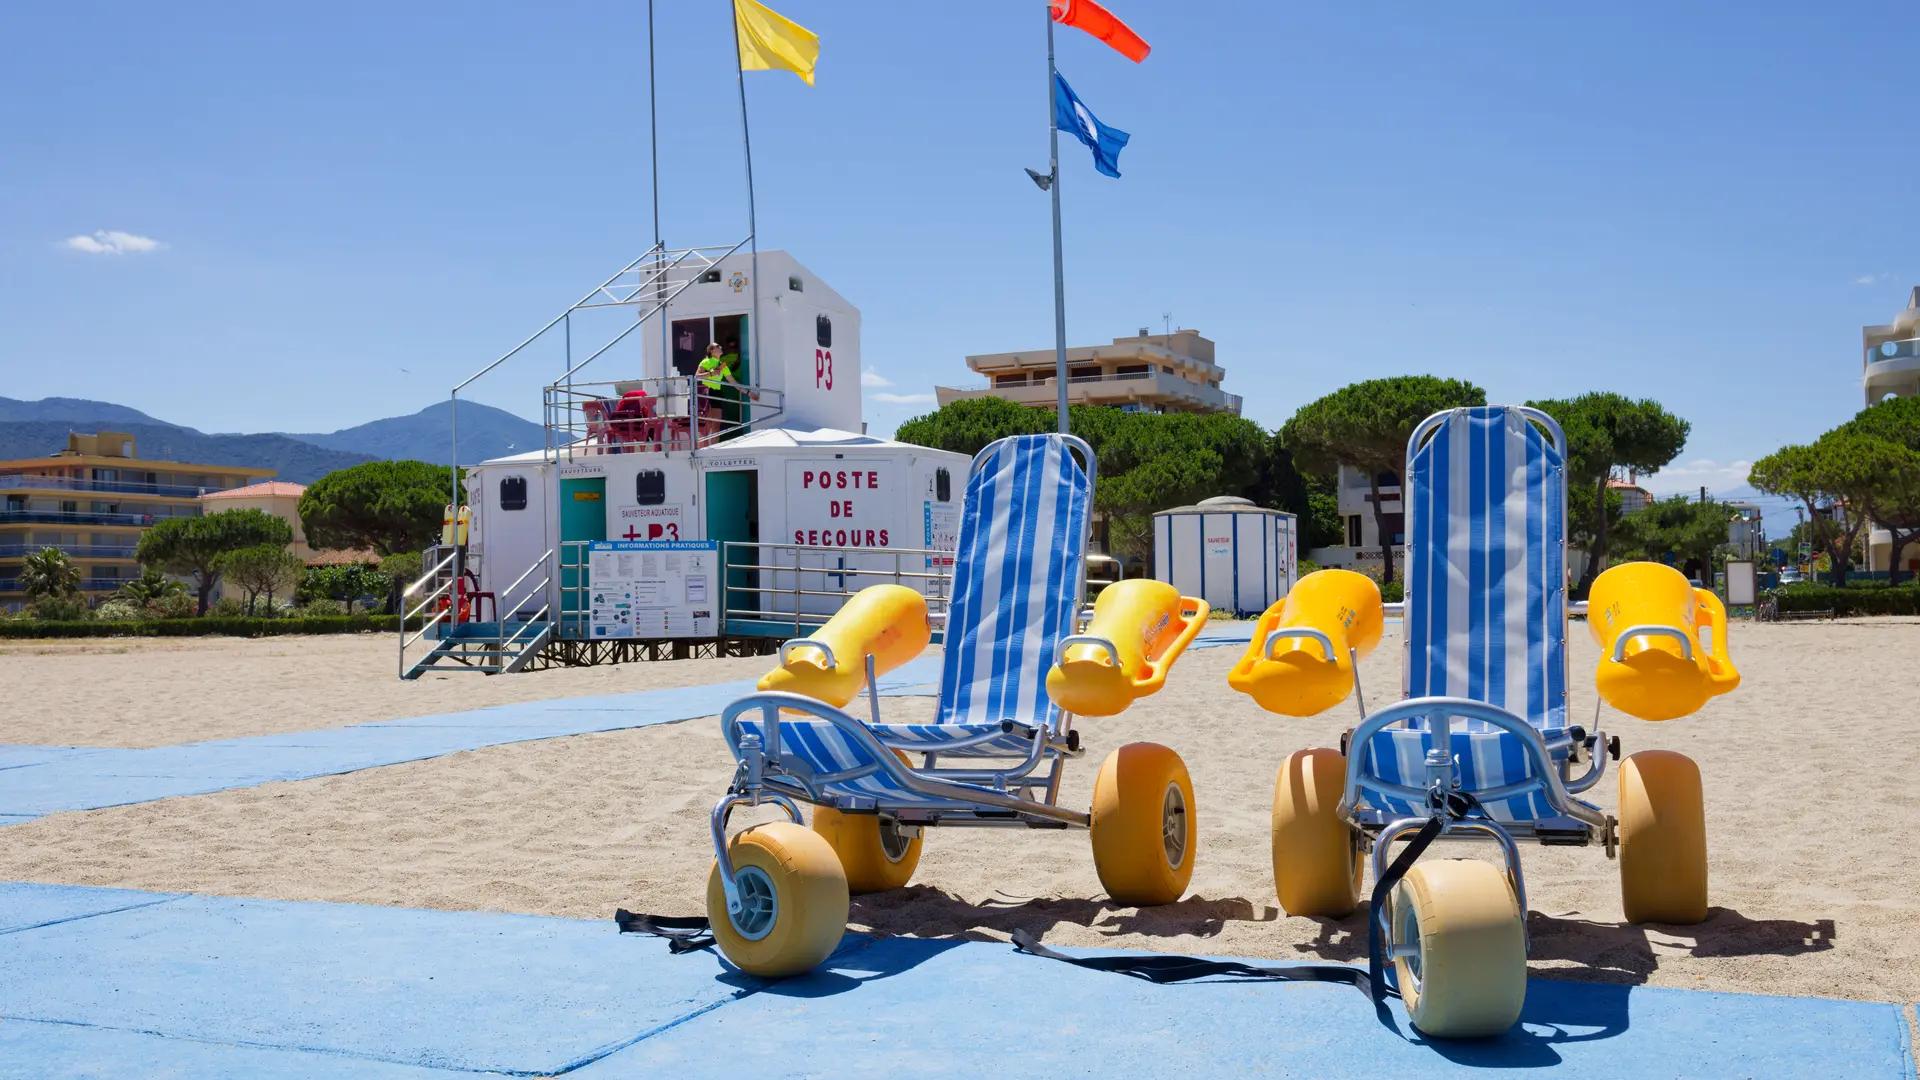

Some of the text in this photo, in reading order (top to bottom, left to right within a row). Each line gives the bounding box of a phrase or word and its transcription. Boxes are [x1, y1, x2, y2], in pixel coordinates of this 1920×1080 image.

[816, 349, 833, 391] P3
[803, 471, 878, 489] POSTE
[621, 507, 679, 518] SAUVETEUR AQUATIQUE
[831, 501, 853, 518] DE
[795, 529, 889, 547] SECOURS
